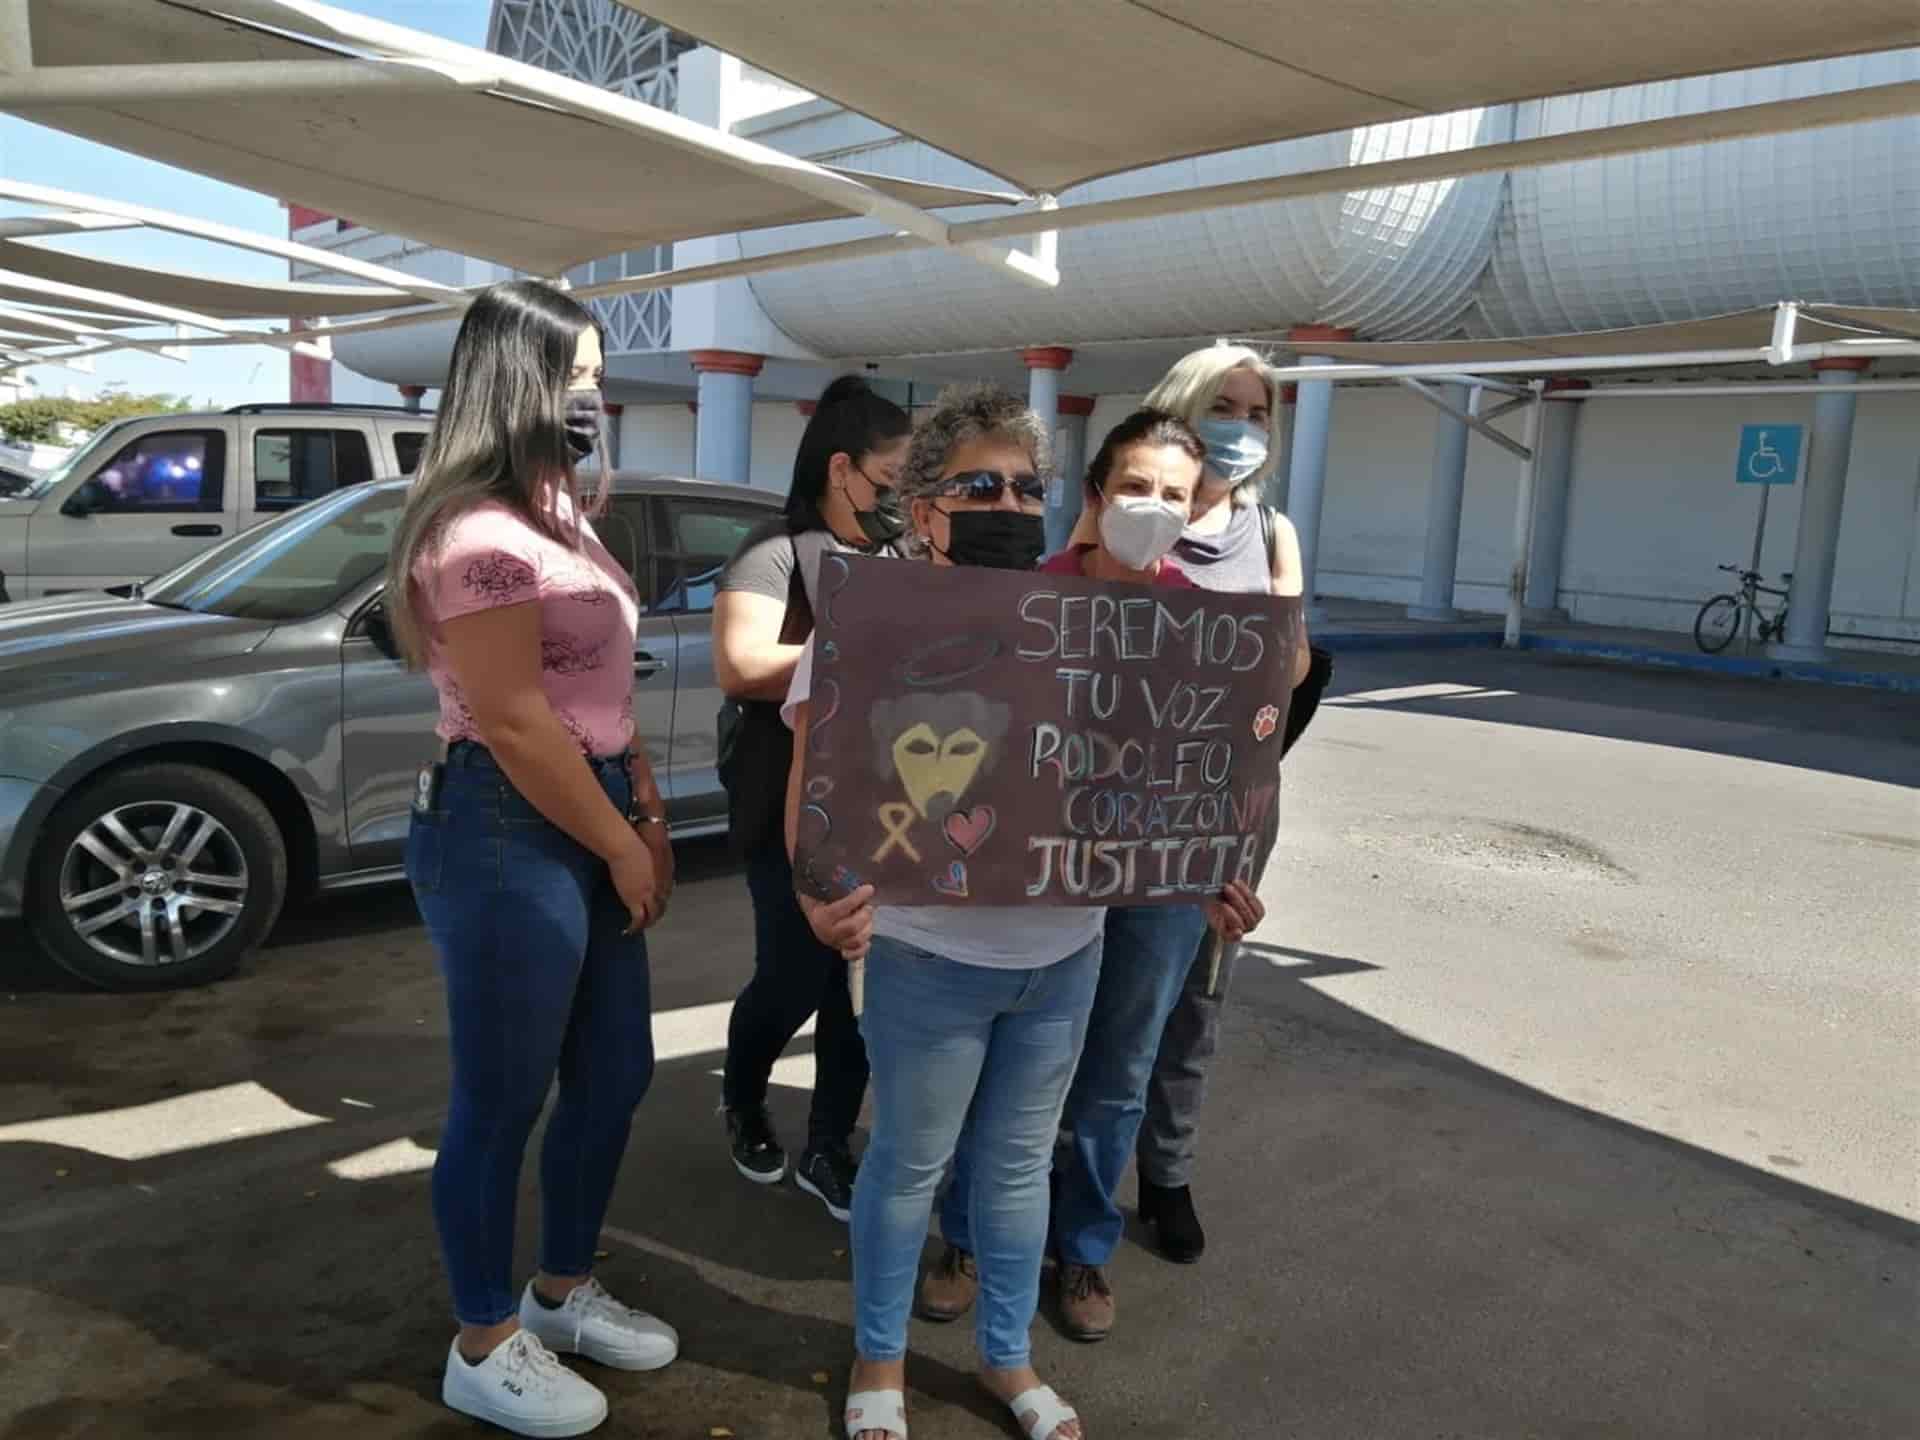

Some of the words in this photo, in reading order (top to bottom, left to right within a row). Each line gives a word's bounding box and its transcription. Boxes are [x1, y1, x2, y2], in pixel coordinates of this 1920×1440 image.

[1018, 590, 1268, 672] SEREMOS
[1056, 667, 1120, 720] TU
[1141, 679, 1233, 733] VOZ
[1031, 723, 1233, 790] RODOLFO
[1025, 833, 1258, 898] JUSTICIA
[502, 1378, 523, 1397] FILA
